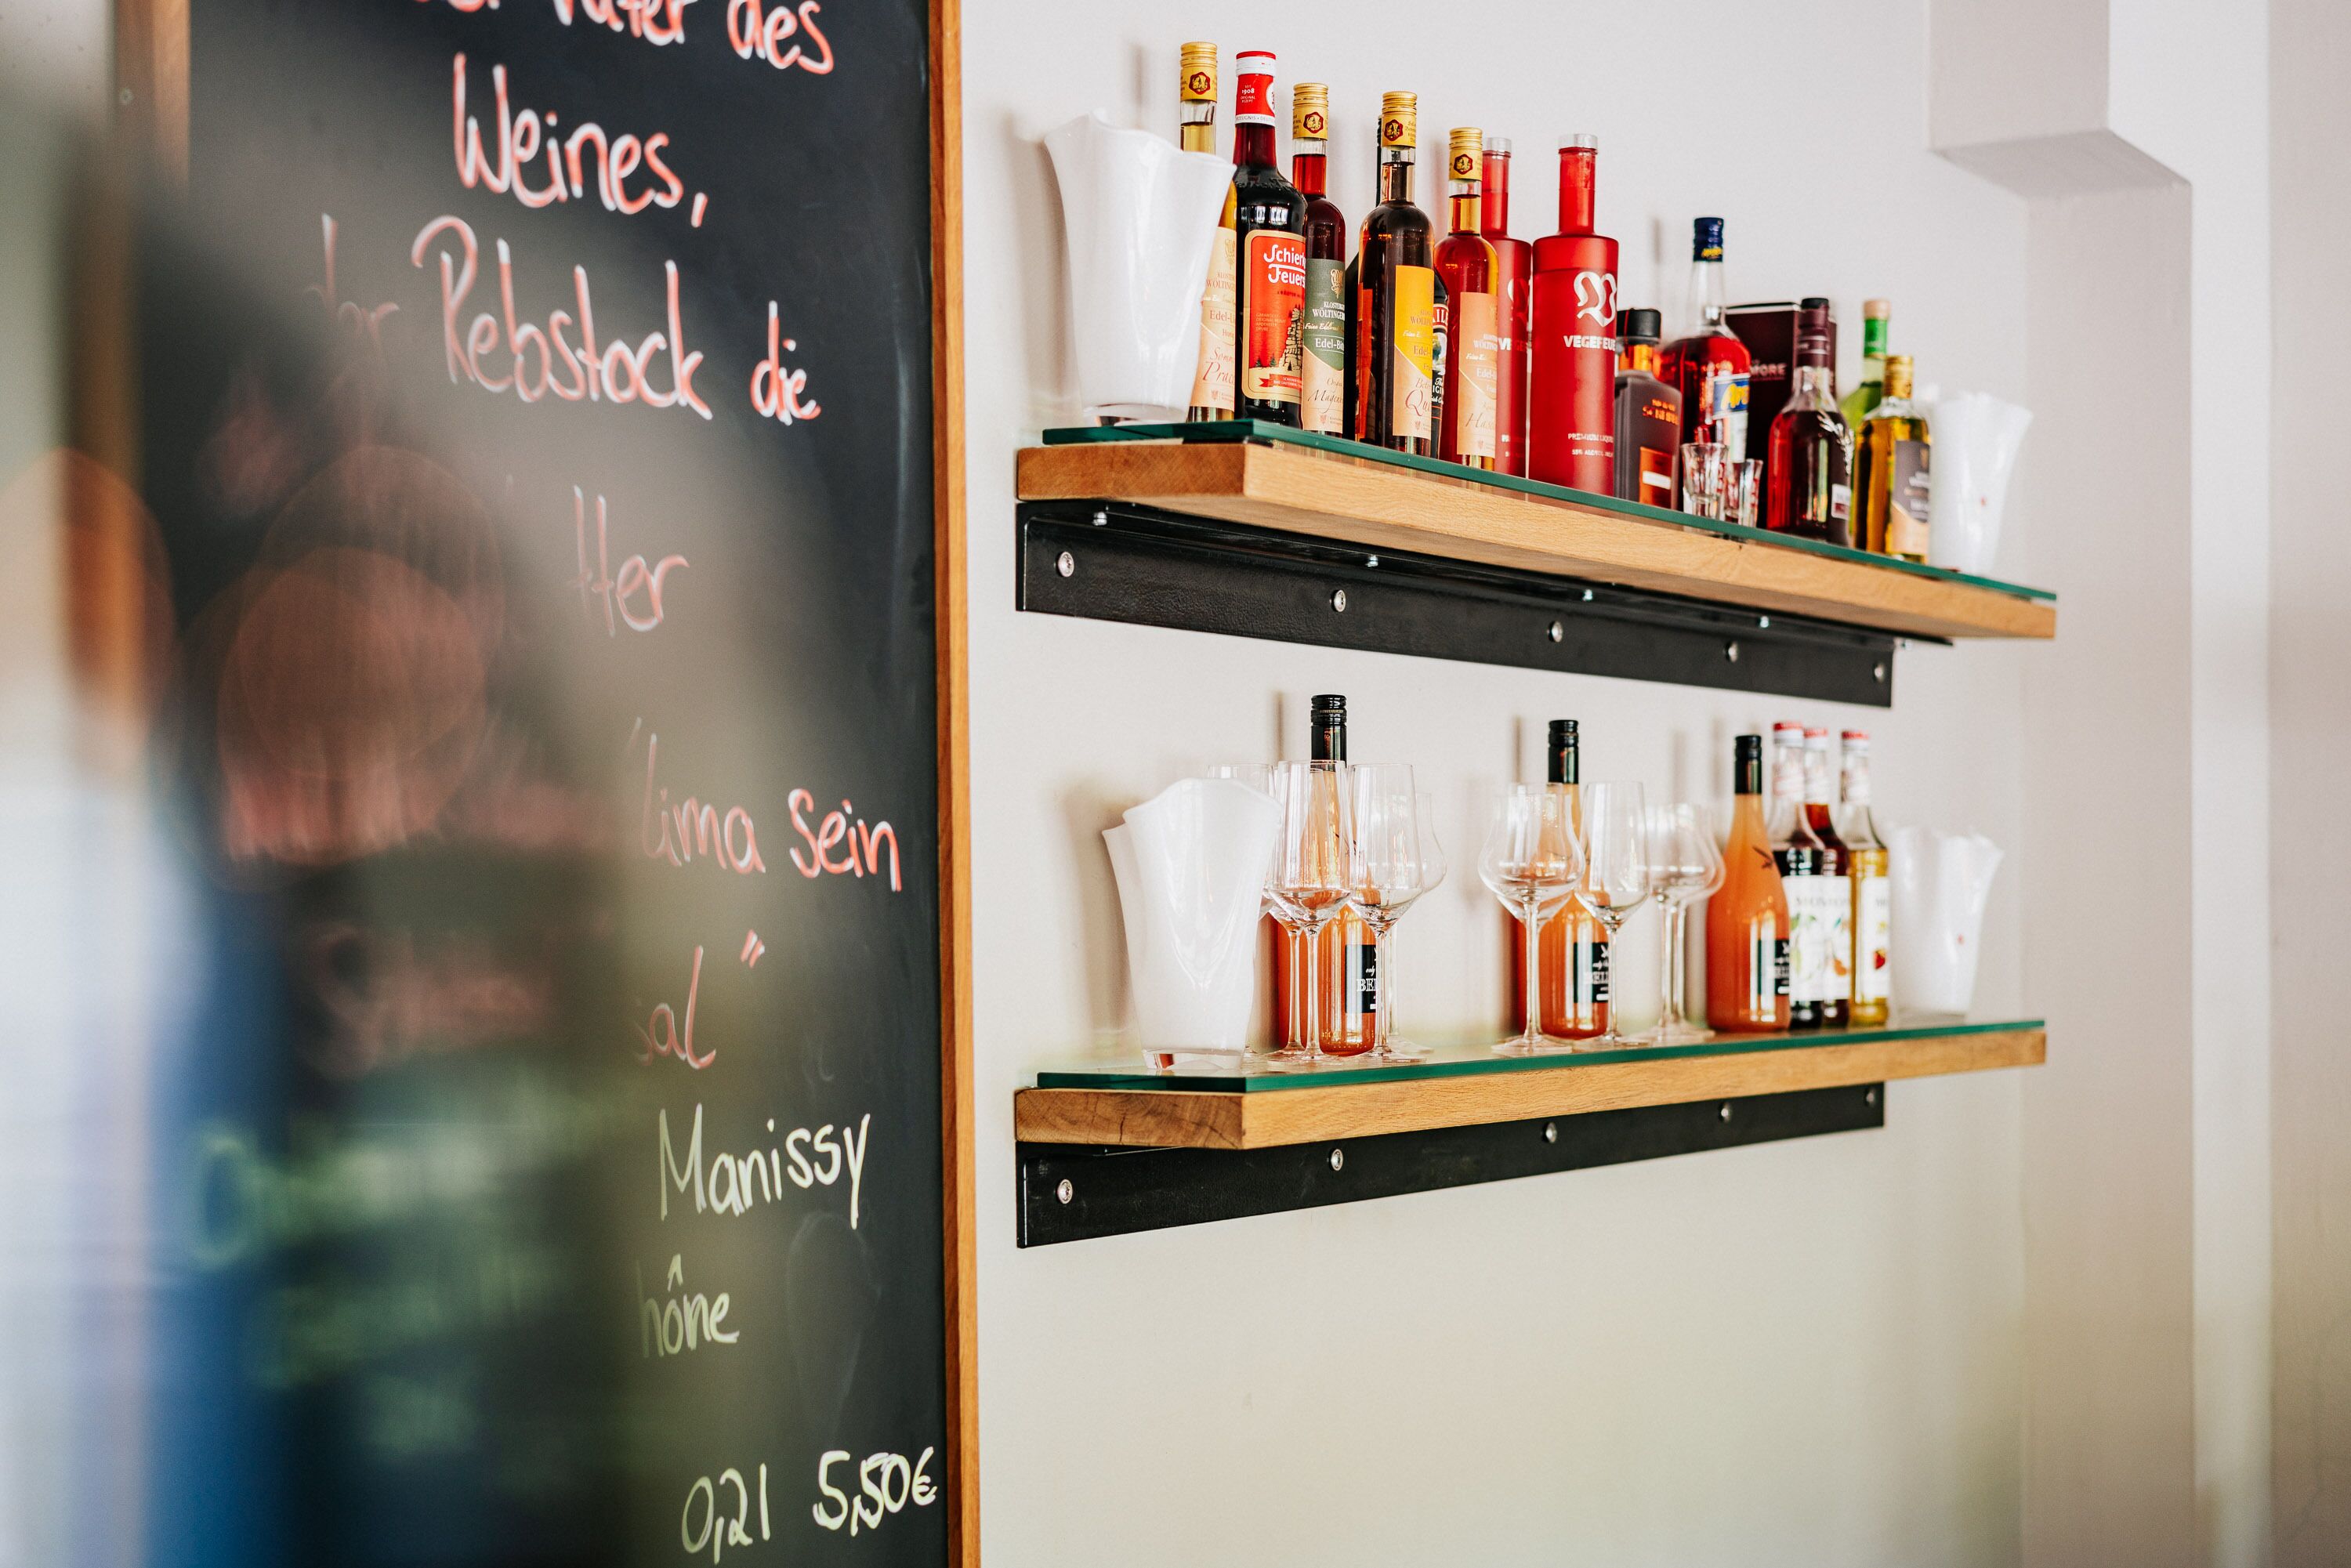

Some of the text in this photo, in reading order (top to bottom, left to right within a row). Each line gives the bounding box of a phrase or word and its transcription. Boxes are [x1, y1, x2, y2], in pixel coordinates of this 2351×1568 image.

[452, 52, 708, 227] Weines,
[411, 215, 714, 420] Rebstock
[750, 301, 822, 425] die
[786, 788, 903, 893] Sein
[658, 1102, 871, 1230] Manissy
[813, 1446, 939, 1536] 5,50€
